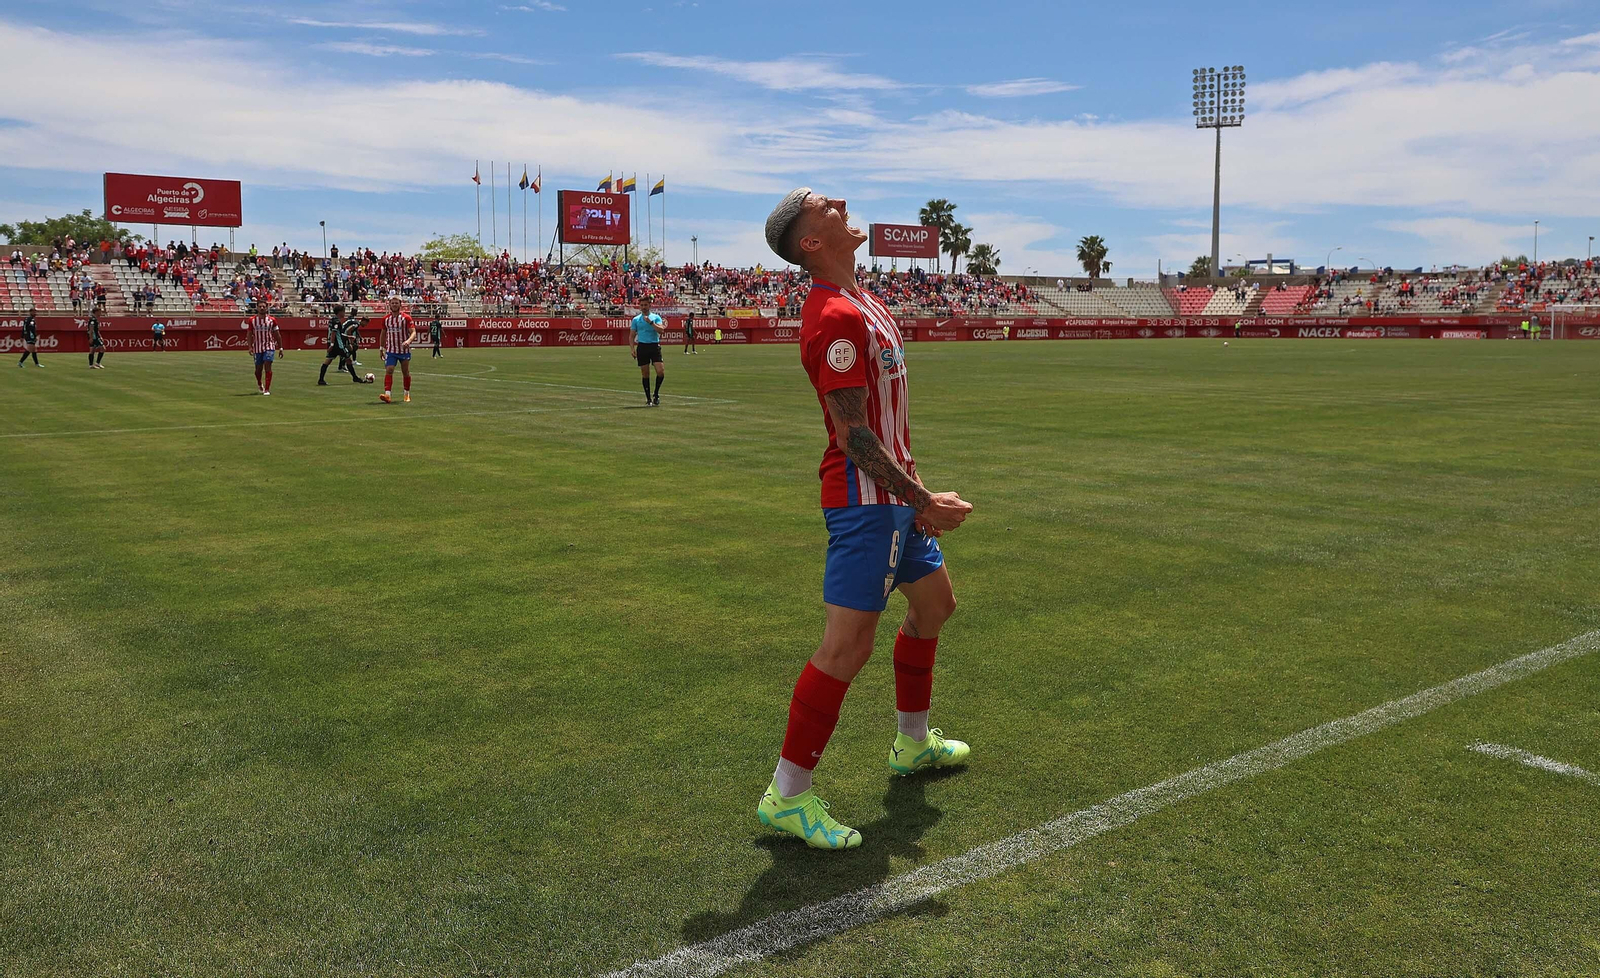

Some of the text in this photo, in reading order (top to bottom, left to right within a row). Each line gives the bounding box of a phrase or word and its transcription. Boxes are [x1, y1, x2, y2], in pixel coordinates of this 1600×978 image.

[157, 188, 180, 196] Puerto
[147, 194, 190, 204] Algeciras
[581, 194, 613, 205] datono
[884, 228, 929, 243] SCAMP
[478, 319, 550, 329] Adecco Adecco
[480, 331, 542, 343] ELEAL S.L. 40
[558, 331, 614, 343] Pepe Valencia
[973, 329, 986, 339] GG
[1298, 328, 1342, 337] NACEX
[128, 338, 180, 347] FACTORY
[888, 529, 900, 568] 6
